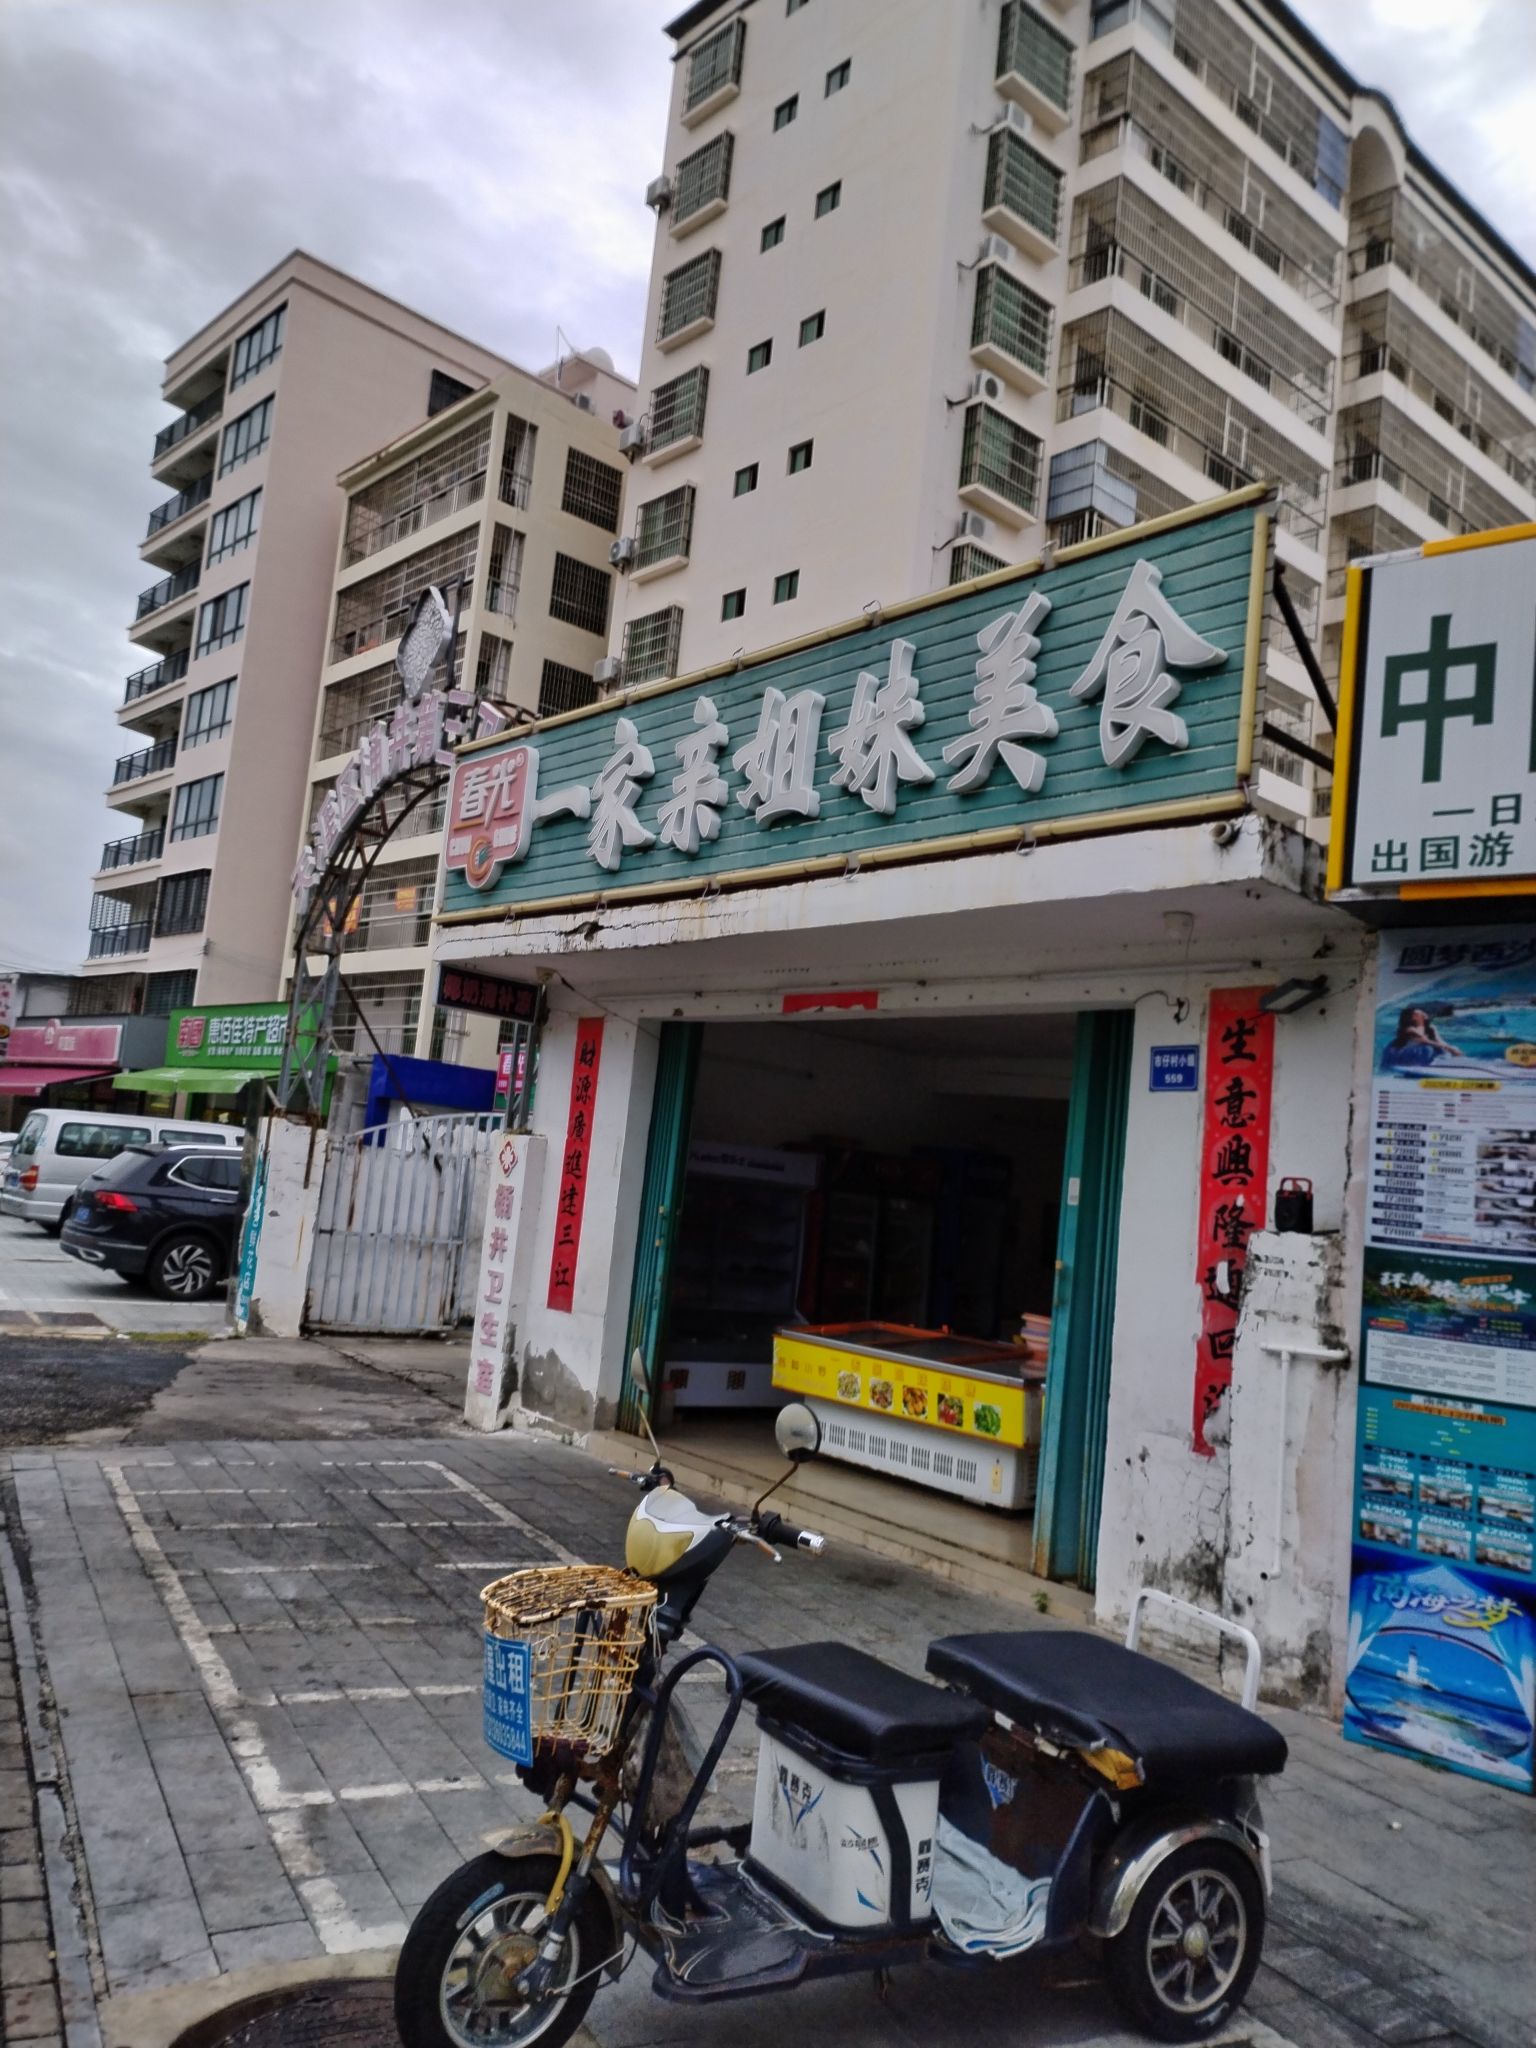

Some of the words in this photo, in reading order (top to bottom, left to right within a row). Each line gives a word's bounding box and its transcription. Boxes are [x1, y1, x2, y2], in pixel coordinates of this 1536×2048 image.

[530, 557, 1229, 871] 一家亲姐妹美食
[1380, 604, 1536, 784] 中
[458, 757, 519, 830] 春光
[1432, 793, 1536, 827] 一日
[1371, 831, 1515, 874] 出国游
